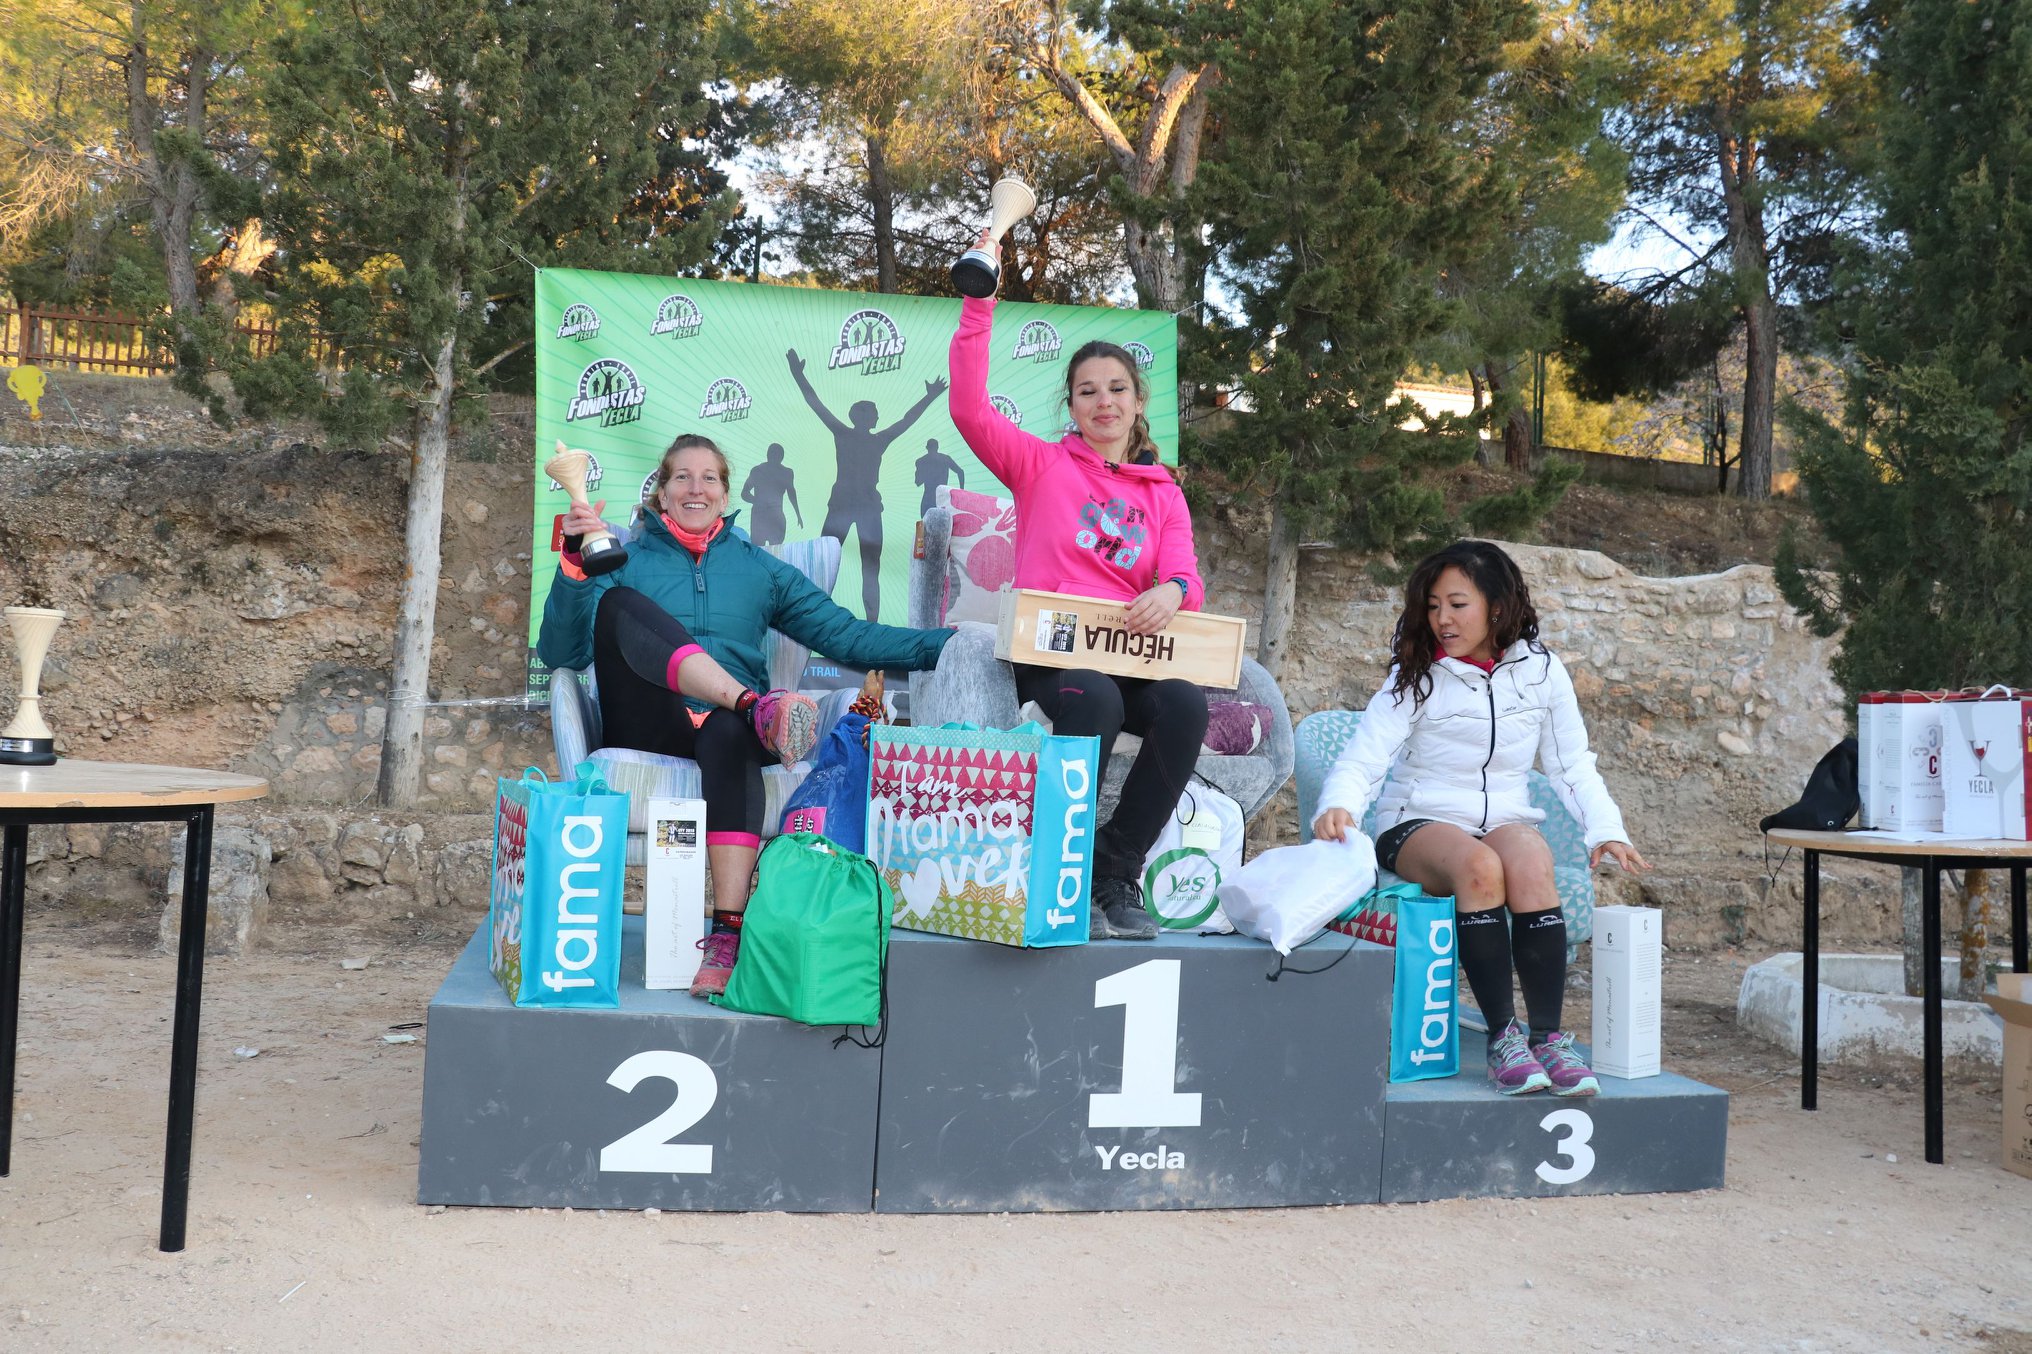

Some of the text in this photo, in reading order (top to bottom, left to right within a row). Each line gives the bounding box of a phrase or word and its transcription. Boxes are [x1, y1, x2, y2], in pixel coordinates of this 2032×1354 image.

[574, 330, 599, 342] YECLA
[671, 326, 700, 340] YECLA
[828, 336, 906, 370] FONDISTAS
[861, 354, 902, 376] YECLA
[566, 386, 646, 421] FONDISTAS
[600, 405, 641, 427] YECLA
[720, 409, 749, 423] YECLA
[810, 666, 841, 678] TRAIL
[917, 776, 969, 798] am
[1968, 779, 1994, 794] YECLA
[896, 799, 1020, 855] fama
[1047, 757, 1090, 930] fama
[543, 815, 603, 993] fama
[1410, 918, 1454, 1066] fama
[1087, 959, 1203, 1128] 1
[600, 1049, 718, 1175] 2
[1094, 1144, 1185, 1171] Yecla
[1534, 1108, 1596, 1185] 3
